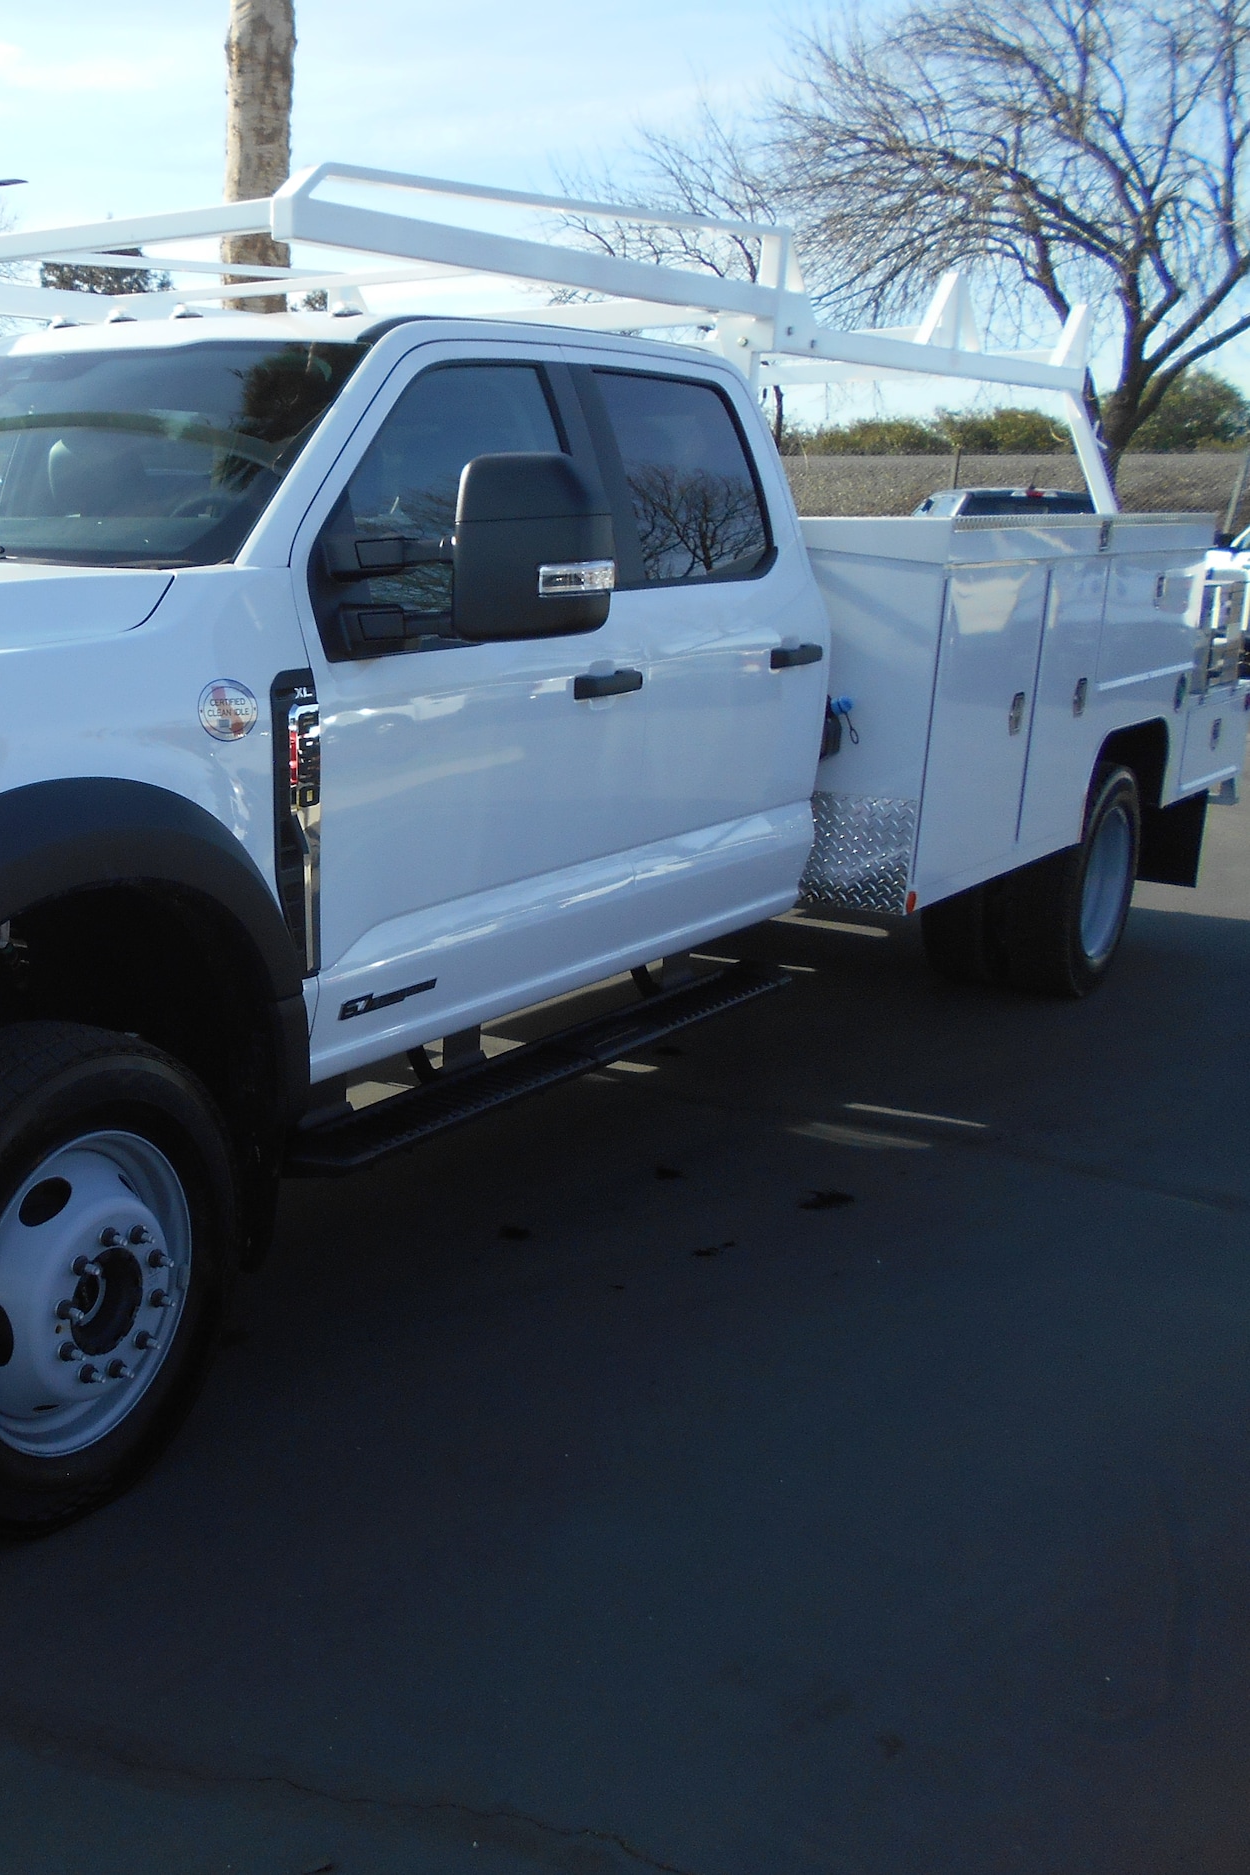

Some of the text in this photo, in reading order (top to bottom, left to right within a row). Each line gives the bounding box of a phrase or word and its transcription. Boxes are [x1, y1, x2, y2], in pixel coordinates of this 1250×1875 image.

[294, 686, 313, 699] XL
[209, 697, 246, 707] CERTIFIED
[207, 708, 232, 717] CLEAN
